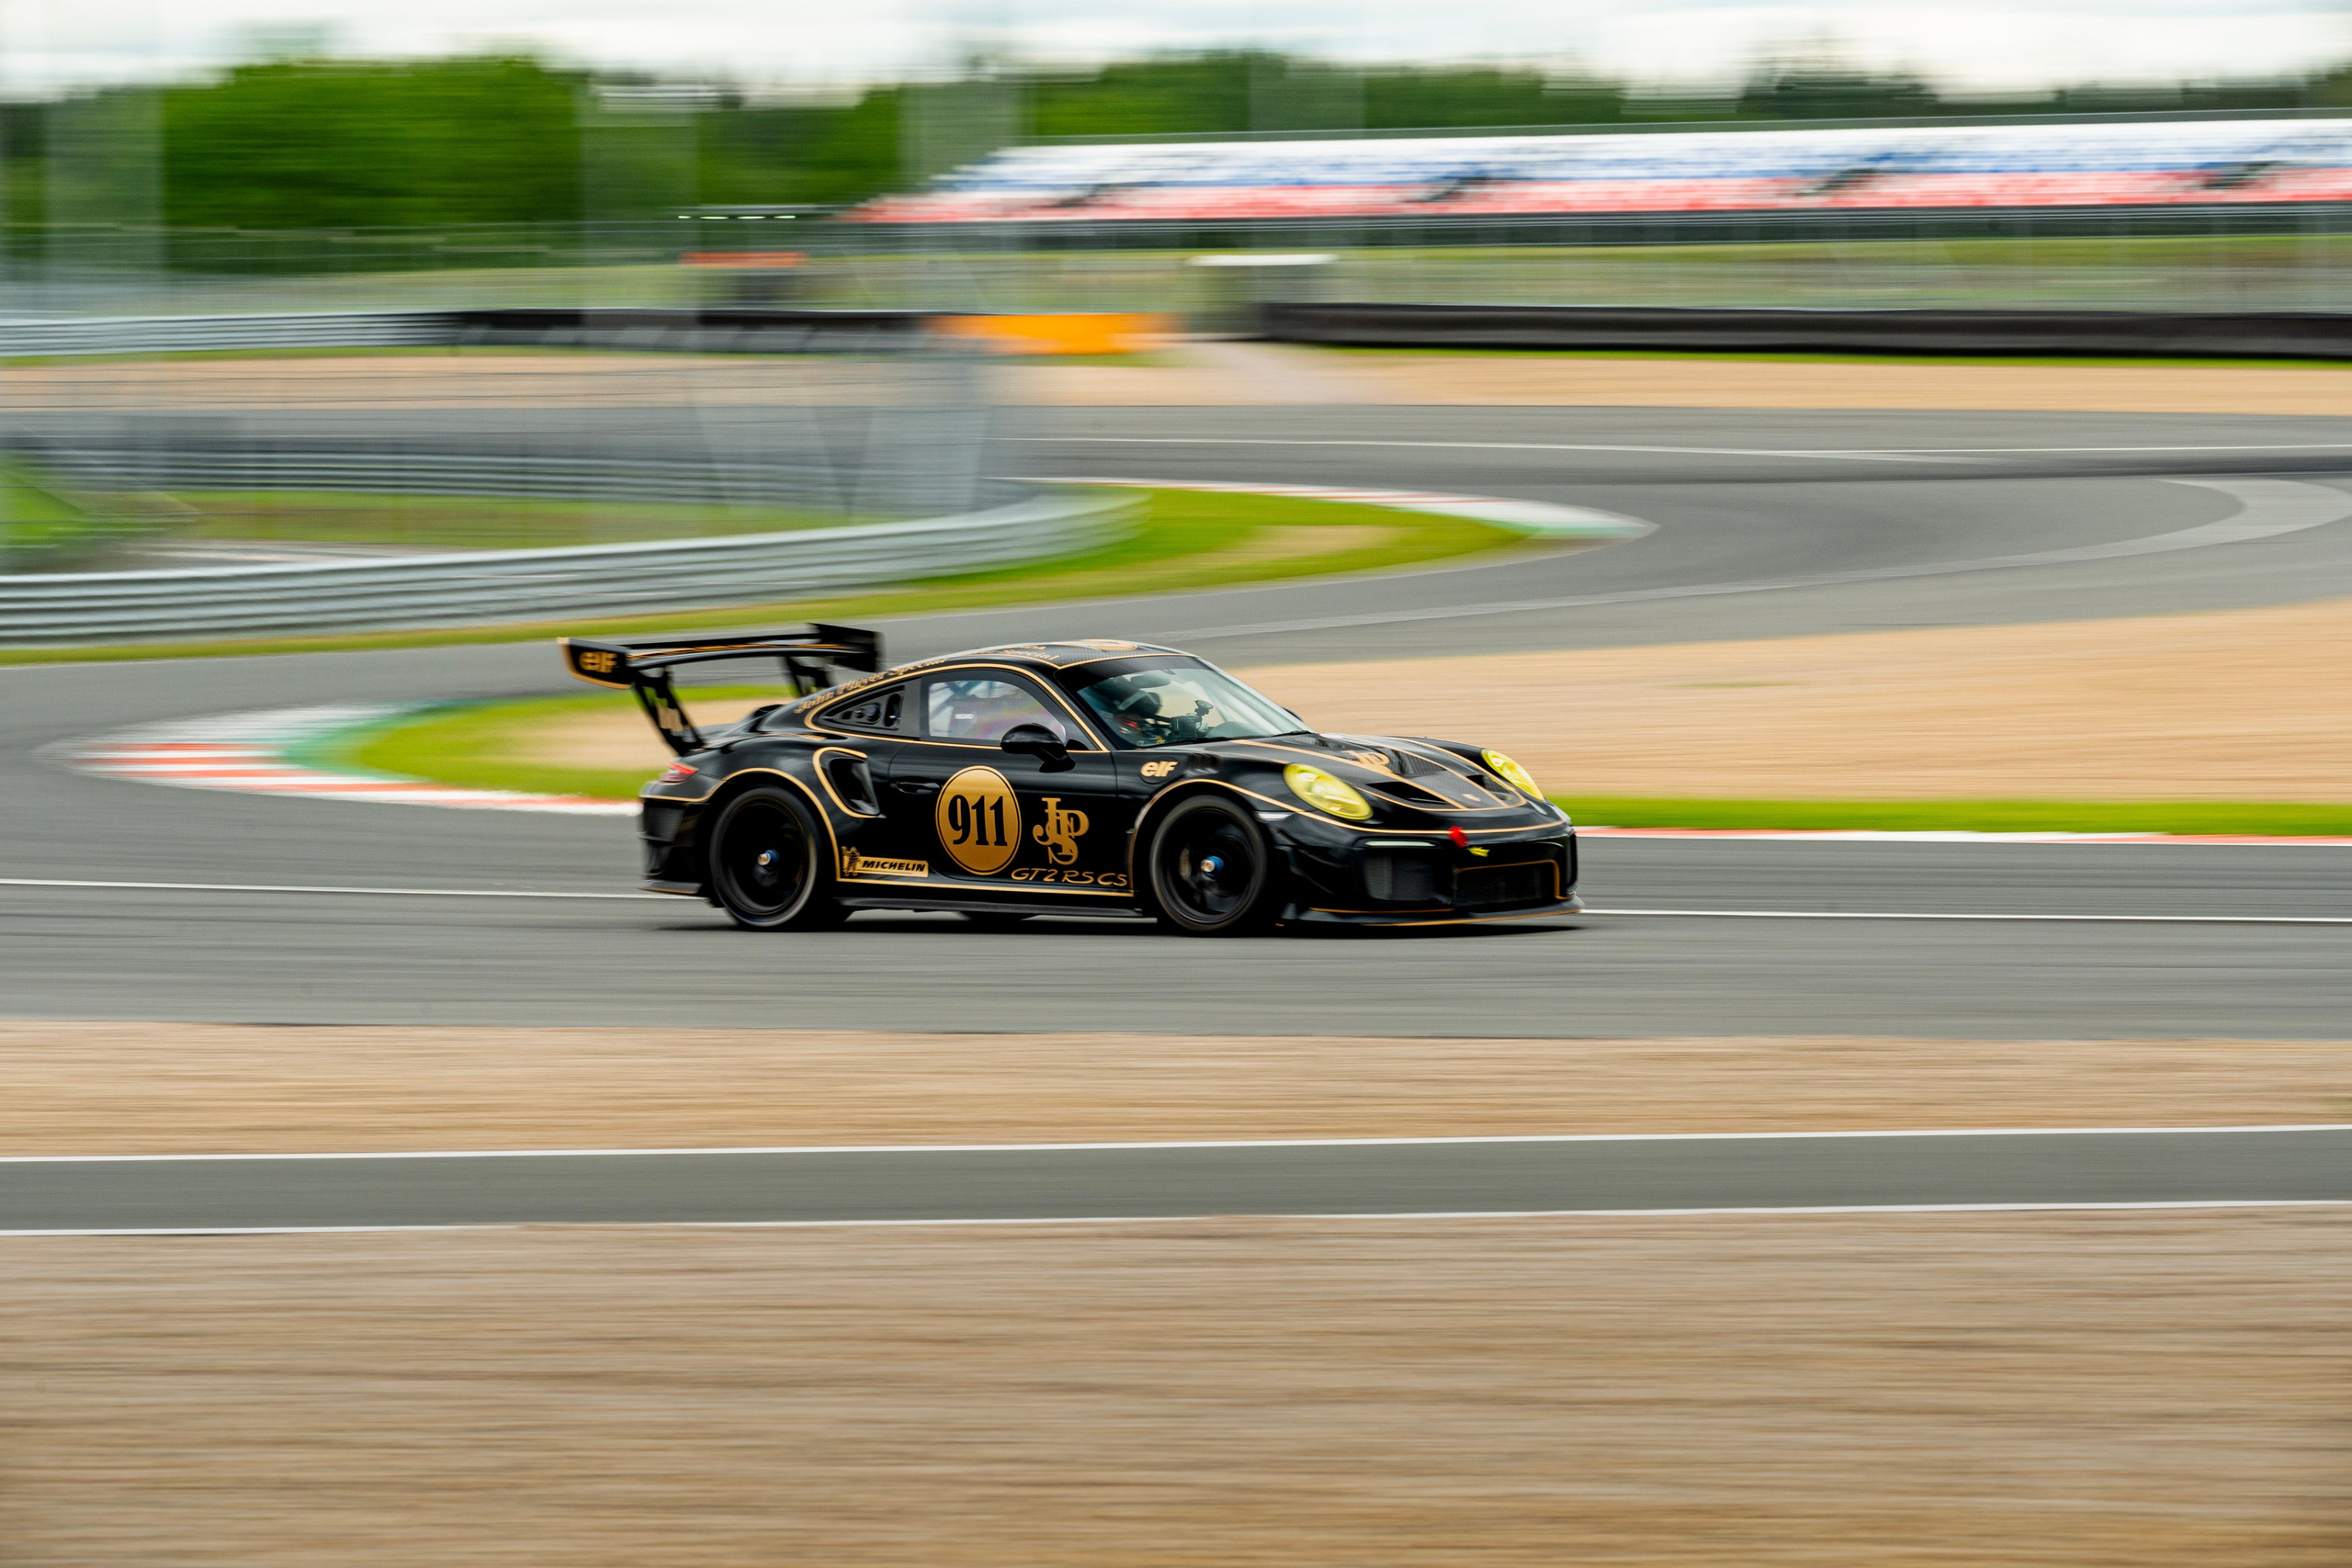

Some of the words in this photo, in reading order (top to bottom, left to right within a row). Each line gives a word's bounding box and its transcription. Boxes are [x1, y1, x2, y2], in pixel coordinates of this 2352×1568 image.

[578, 650, 617, 673] elf
[793, 691, 835, 714] John
[1140, 761, 1179, 777] elf
[948, 795, 1008, 847] 911
[862, 860, 926, 873] MICHELIN
[1011, 867, 1058, 882] GT2
